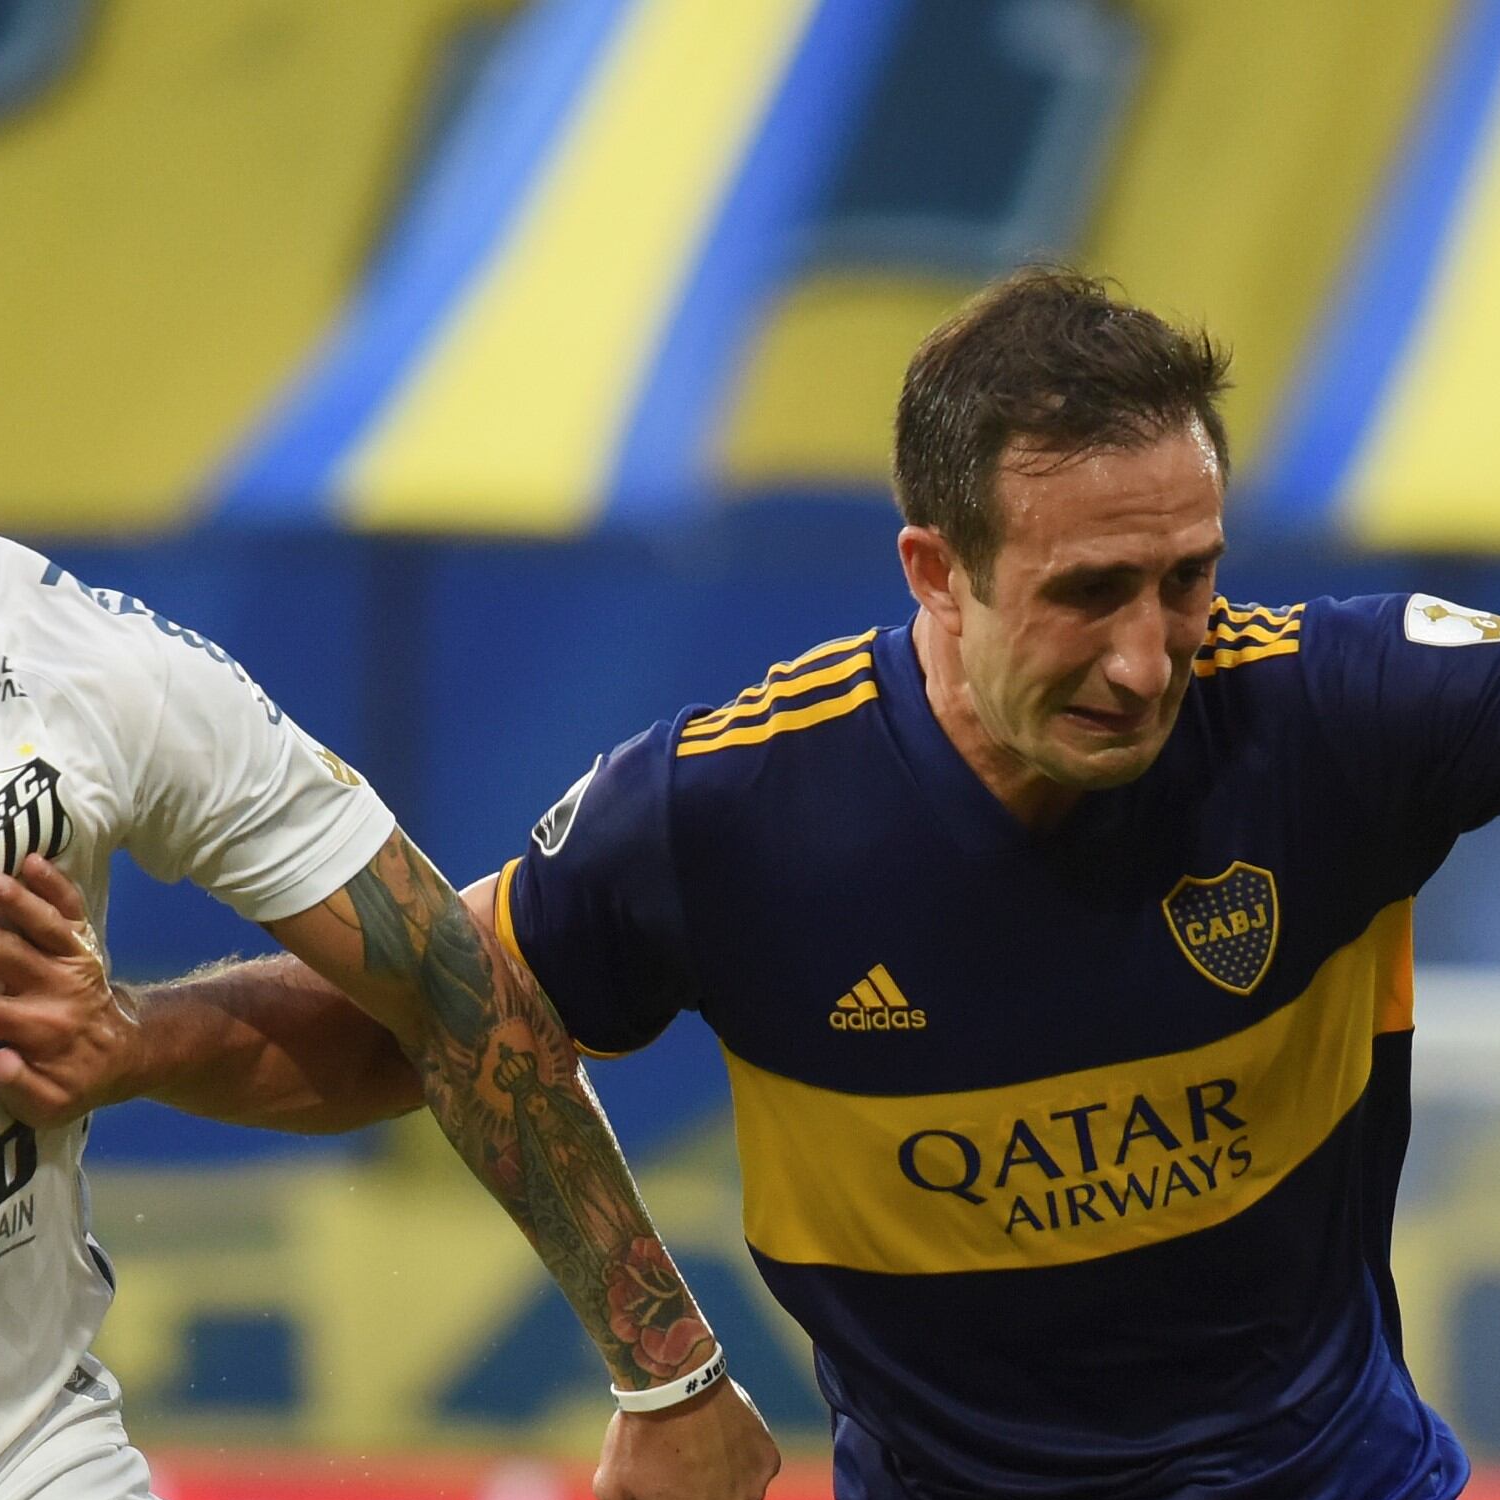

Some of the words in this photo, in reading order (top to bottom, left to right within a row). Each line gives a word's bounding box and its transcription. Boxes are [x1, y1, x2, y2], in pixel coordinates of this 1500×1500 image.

[1185, 903, 1267, 948] CABJ
[829, 1004, 927, 1031] adidas
[898, 1076, 1247, 1205] QATAR
[1004, 1135, 1252, 1235] AIRWAYS
